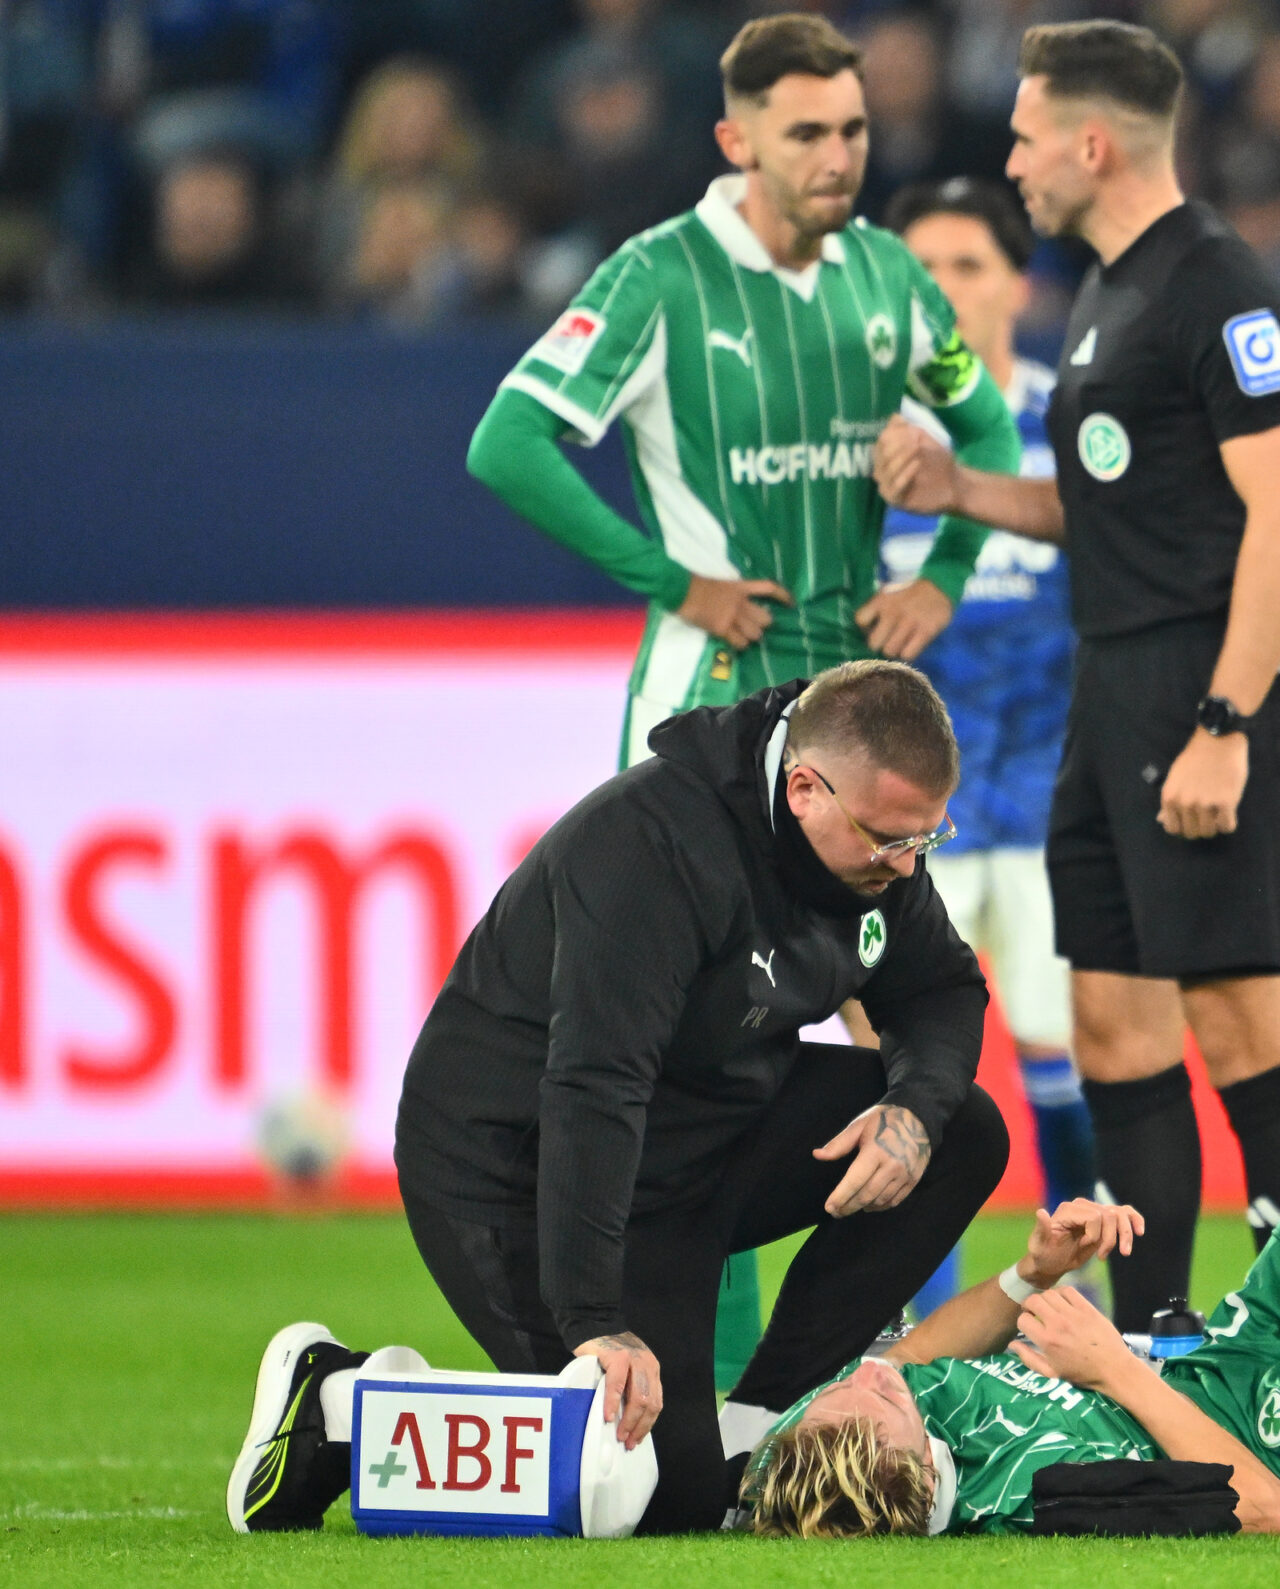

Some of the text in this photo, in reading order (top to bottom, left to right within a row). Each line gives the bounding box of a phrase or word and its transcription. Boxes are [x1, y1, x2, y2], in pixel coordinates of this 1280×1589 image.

[729, 443, 875, 485] HOFMAN
[741, 1006, 769, 1028] PR
[390, 1411, 544, 1494] ABF
